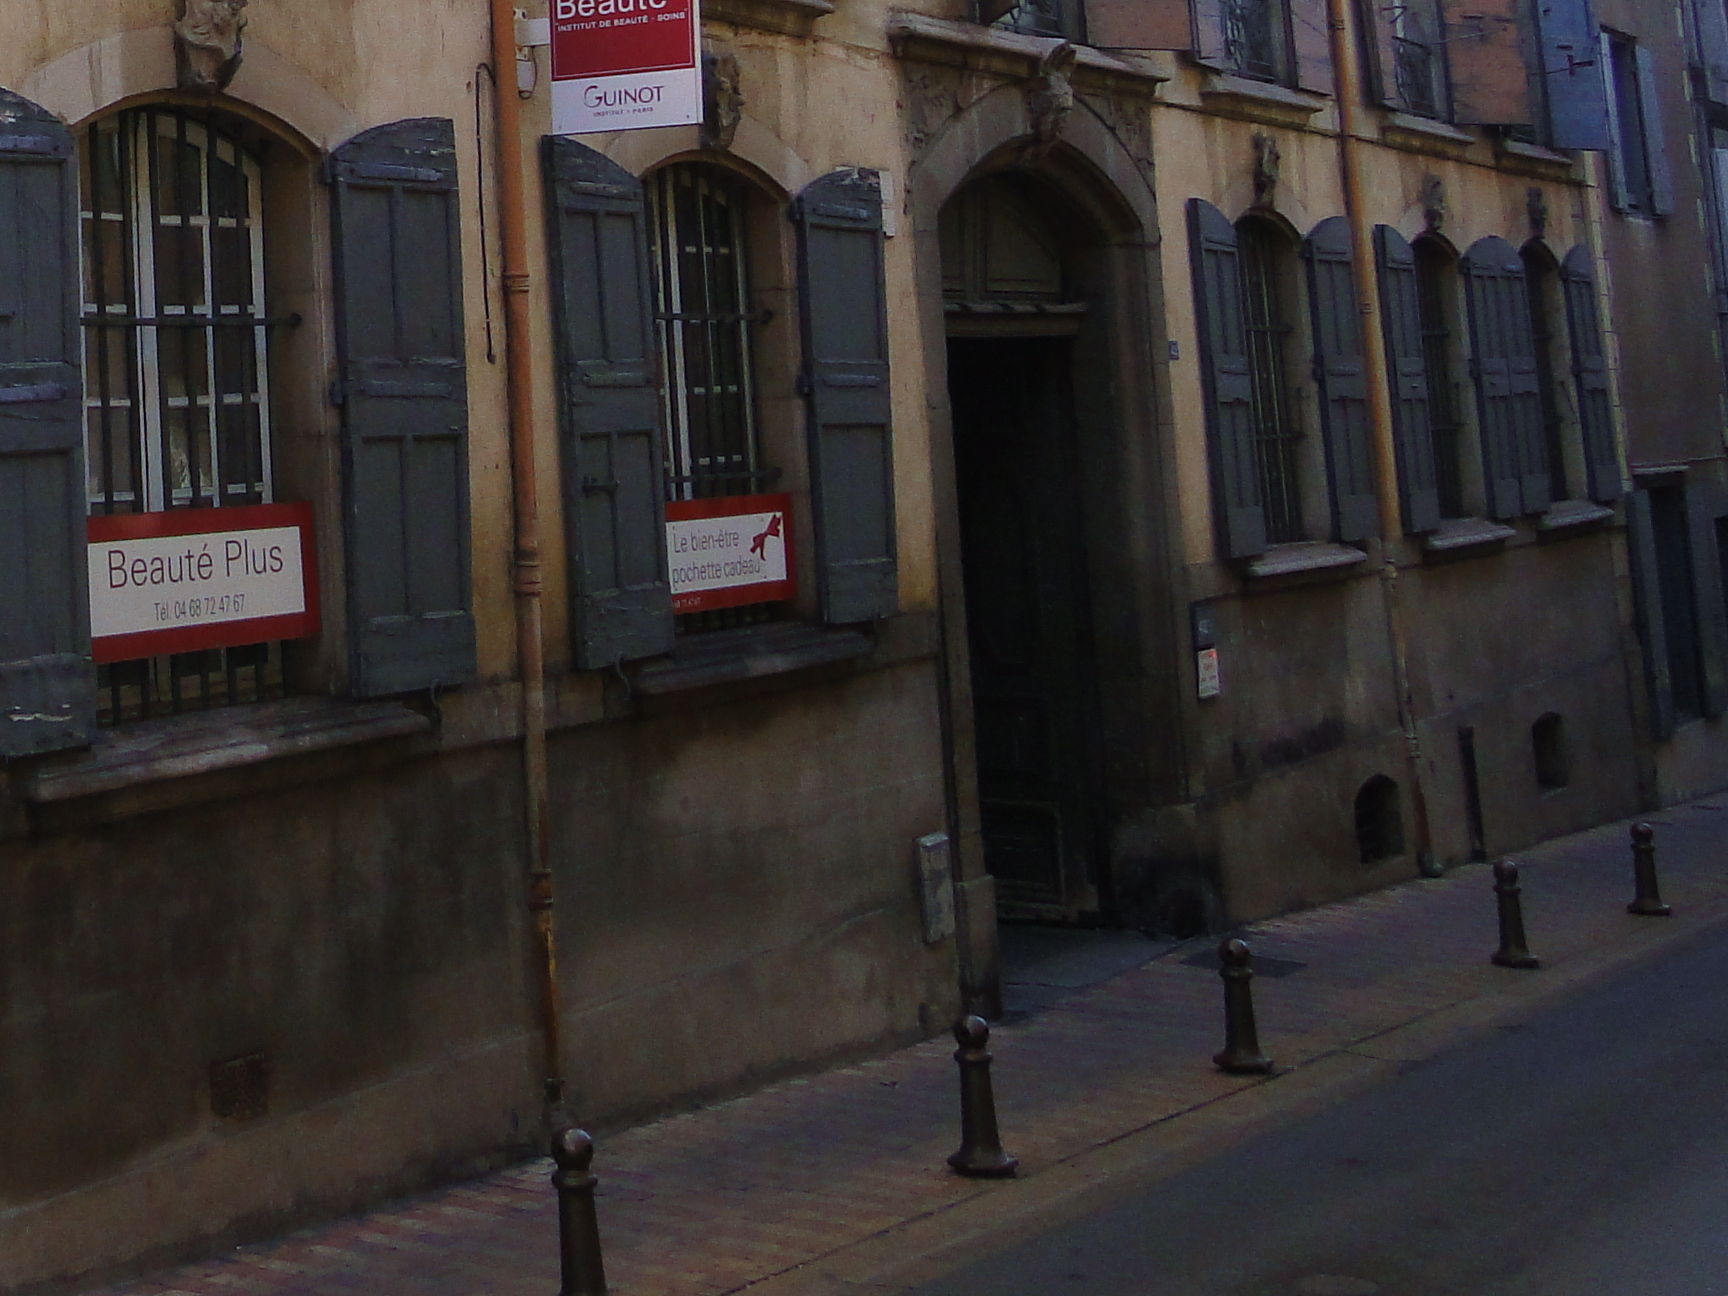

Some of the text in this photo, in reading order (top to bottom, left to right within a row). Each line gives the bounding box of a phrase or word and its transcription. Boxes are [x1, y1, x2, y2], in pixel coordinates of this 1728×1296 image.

[599, 19, 611, 28] DE
[614, 15, 648, 26] BEAUTÉ
[583, 85, 665, 109] GUINOT
[673, 529, 740, 554] Le bien-être
[107, 538, 284, 589] Beauté Plus
[672, 555, 761, 585] pochette cadeau
[174, 600, 187, 619] 04
[189, 598, 201, 617] 68
[204, 597, 216, 615] 72
[219, 595, 230, 613] 47
[233, 593, 245, 612] 67
